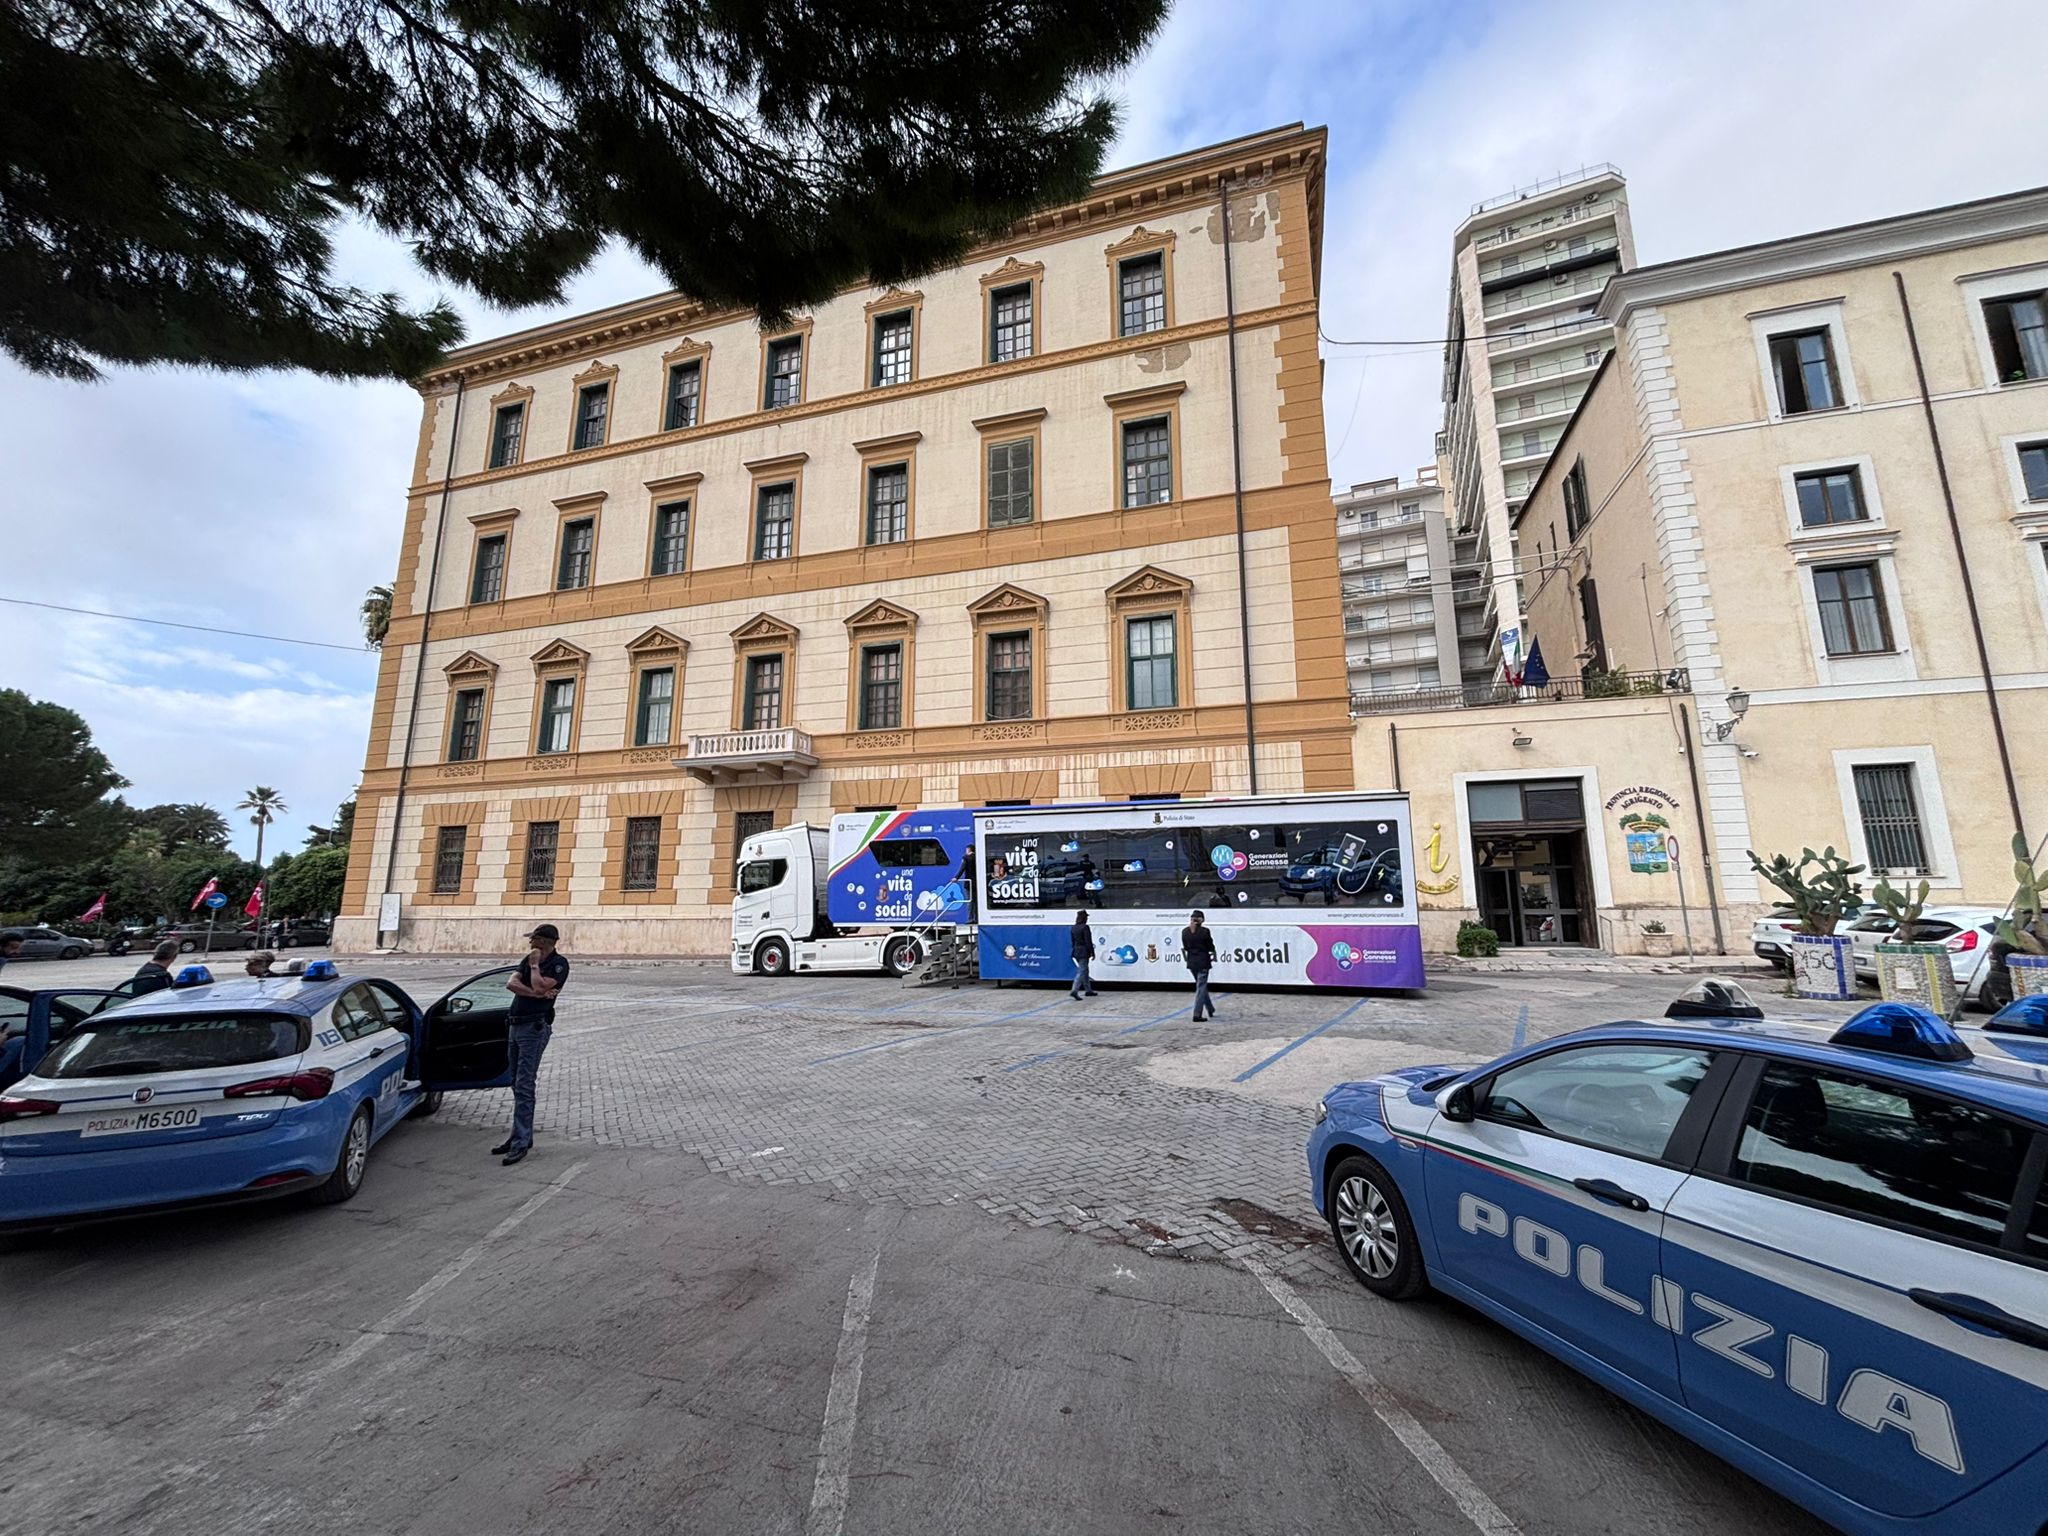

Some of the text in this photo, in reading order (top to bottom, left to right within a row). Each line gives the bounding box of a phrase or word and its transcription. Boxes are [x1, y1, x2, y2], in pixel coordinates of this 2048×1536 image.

[1605, 786, 1680, 810] PROVINCIA REGIONALE
[1621, 796, 1664, 809] AGRIGENTO
[1022, 838, 1039, 847] una
[1005, 846, 1038, 866] vita
[1248, 852, 1289, 860] Generazioni
[887, 875, 913, 891] vita
[992, 878, 1039, 898] social
[875, 900, 912, 917] social
[1165, 952, 1182, 963] una
[1220, 950, 1232, 963] da
[1233, 942, 1290, 964] social
[117, 1020, 238, 1036] POLIZIA
[87, 1108, 198, 1132] POLIZIA M6500
[1457, 1191, 1966, 1475] POLIZIA
